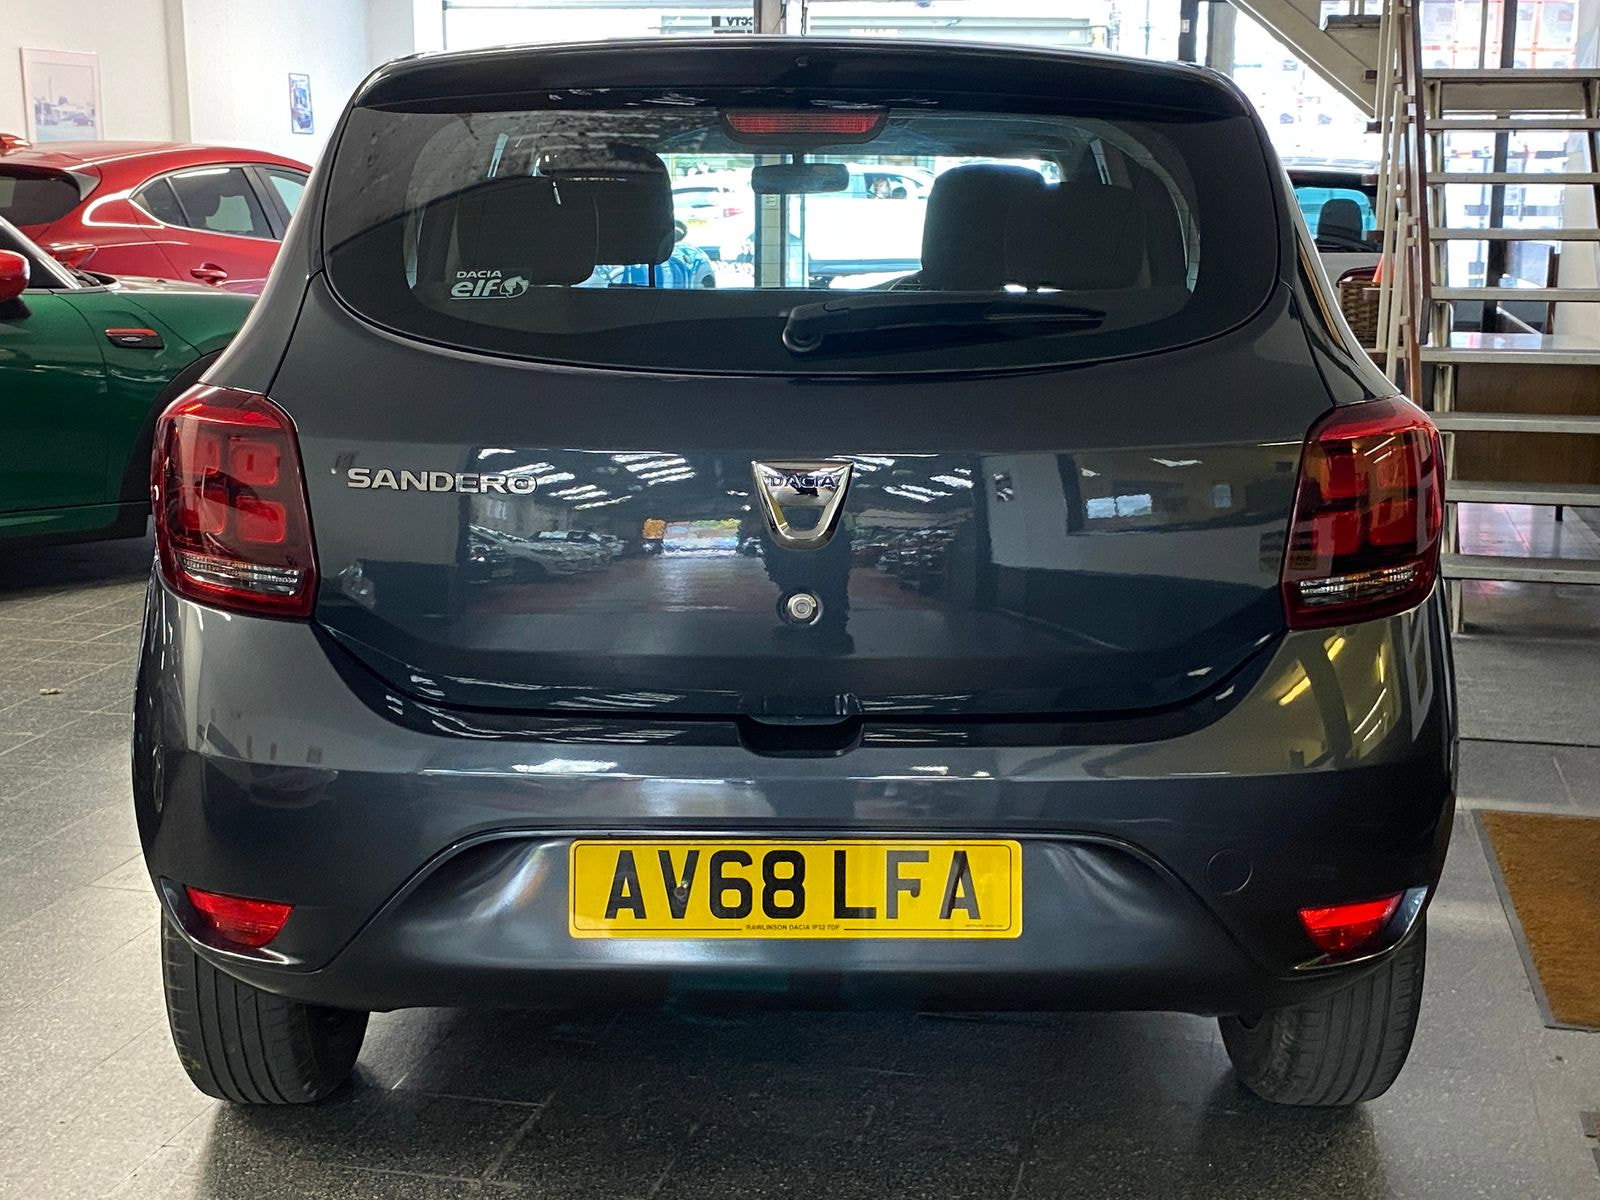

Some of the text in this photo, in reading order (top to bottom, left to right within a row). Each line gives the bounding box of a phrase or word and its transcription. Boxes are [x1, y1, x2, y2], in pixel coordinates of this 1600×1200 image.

[456, 270, 502, 279] DACIA
[450, 279, 501, 297] elf
[347, 467, 538, 495] SANDERO
[769, 474, 836, 489] DACIA
[604, 849, 982, 920] AV68 LFA
